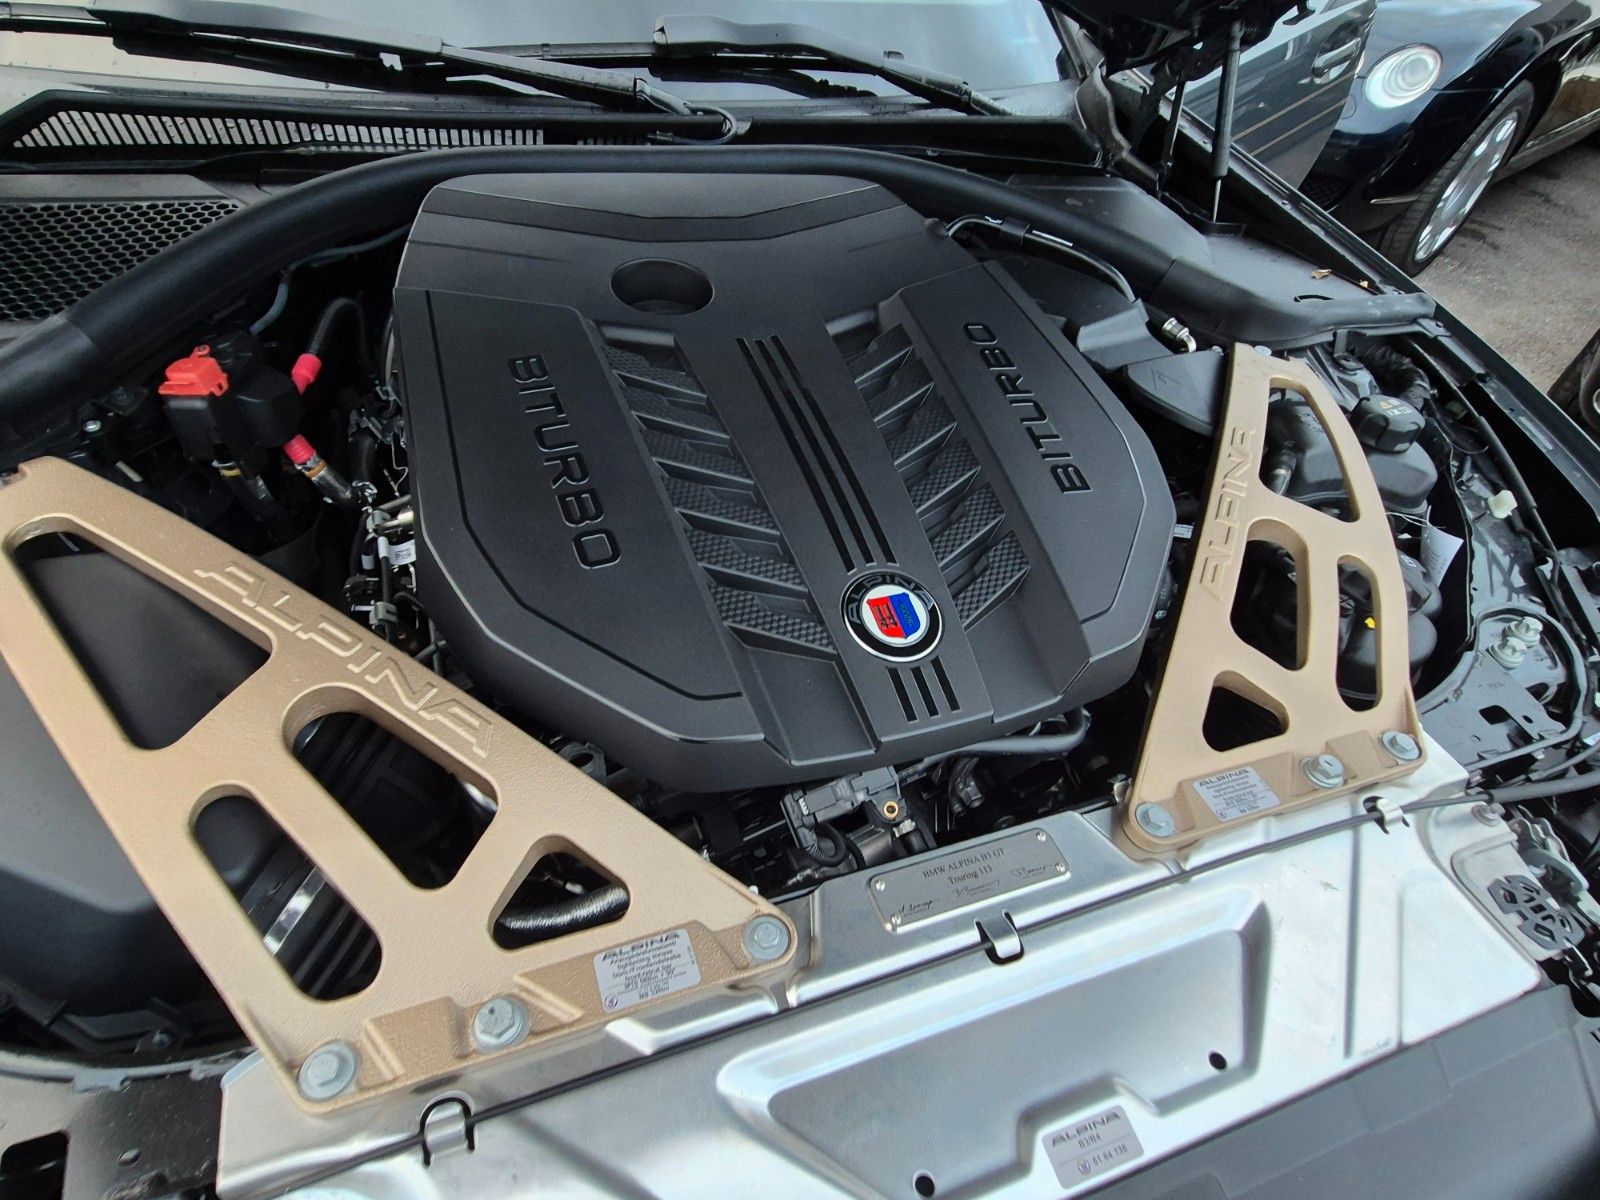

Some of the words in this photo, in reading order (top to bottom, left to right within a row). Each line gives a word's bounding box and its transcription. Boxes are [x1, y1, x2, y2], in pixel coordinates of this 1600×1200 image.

[963, 321, 1092, 494] BITURBO
[507, 353, 621, 569] BITURBO
[1199, 426, 1256, 601] ALPINA
[847, 573, 935, 624] ALPINA
[193, 560, 494, 758] ALPINA
[1199, 769, 1249, 787] ALPINA
[922, 866, 945, 880] BMW
[948, 855, 980, 873] ALPINA
[993, 848, 1005, 861] GT
[947, 869, 979, 885] Touring
[602, 932, 680, 961] ALPINA
[1052, 1112, 1120, 1147] ALPINA
